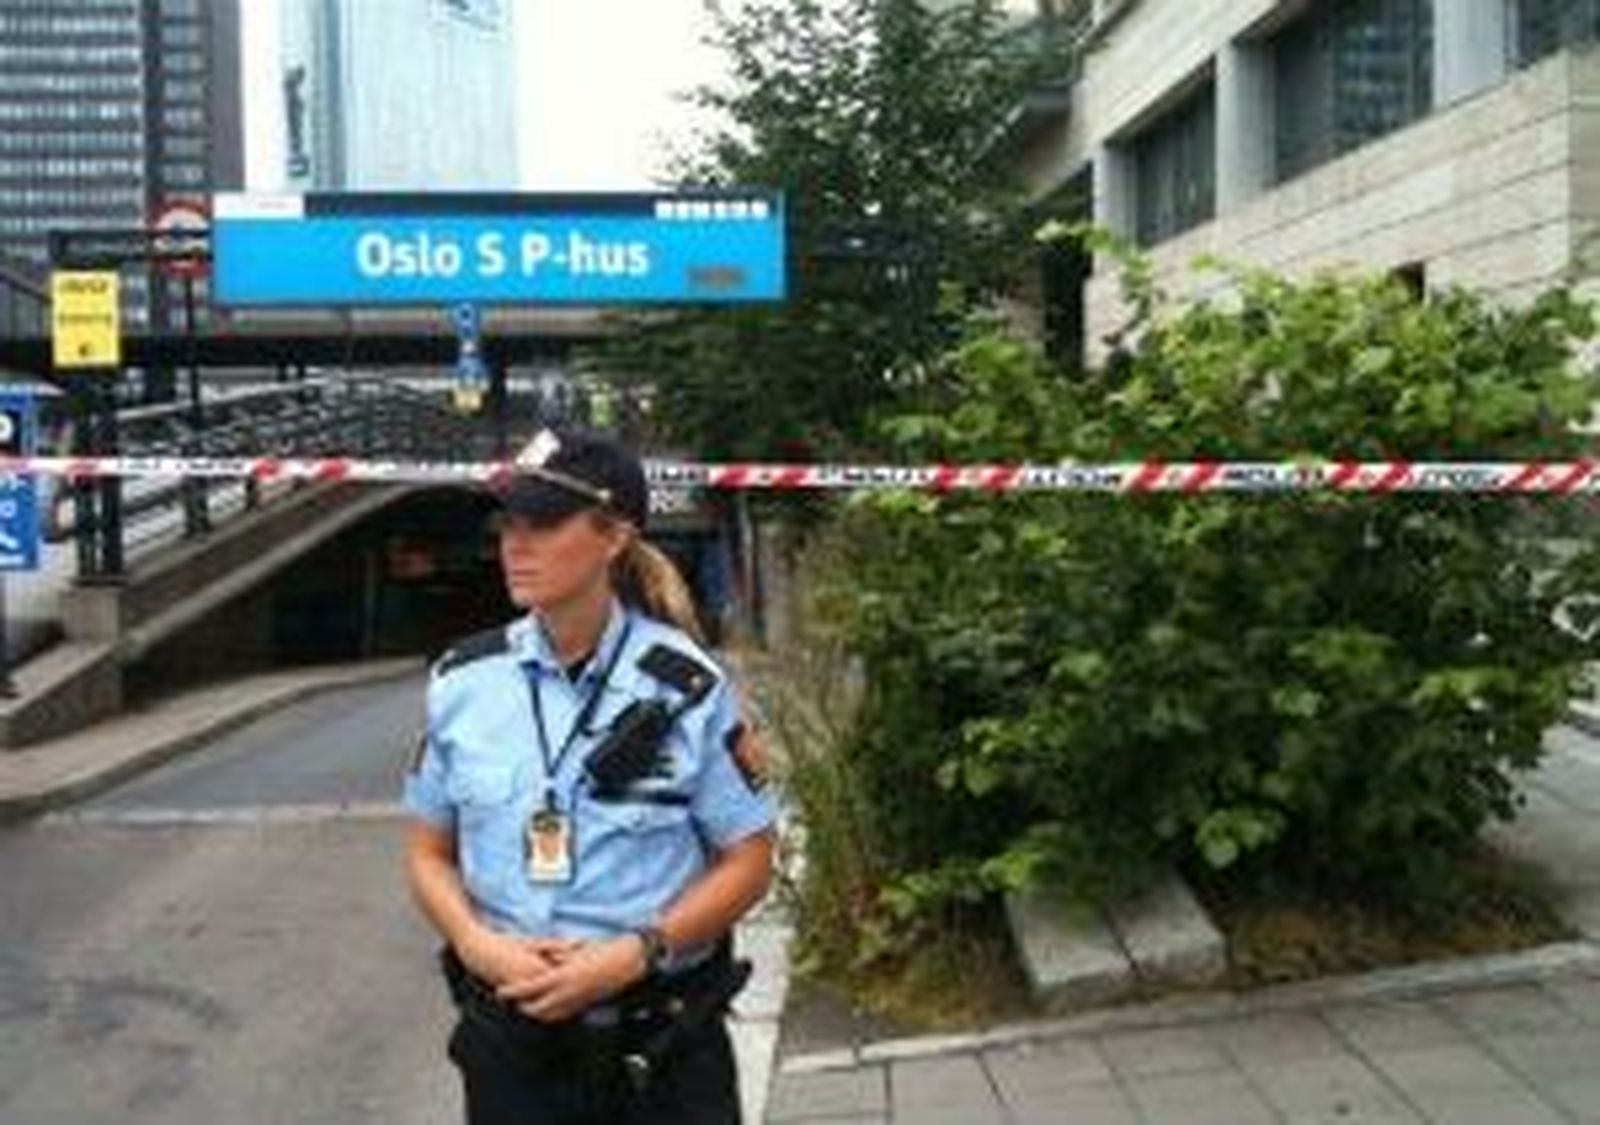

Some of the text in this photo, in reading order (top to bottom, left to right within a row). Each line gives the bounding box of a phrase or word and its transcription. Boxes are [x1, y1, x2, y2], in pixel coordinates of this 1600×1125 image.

[357, 233, 462, 277] Oslo
[477, 233, 507, 276] S
[522, 233, 650, 276] P-hus
